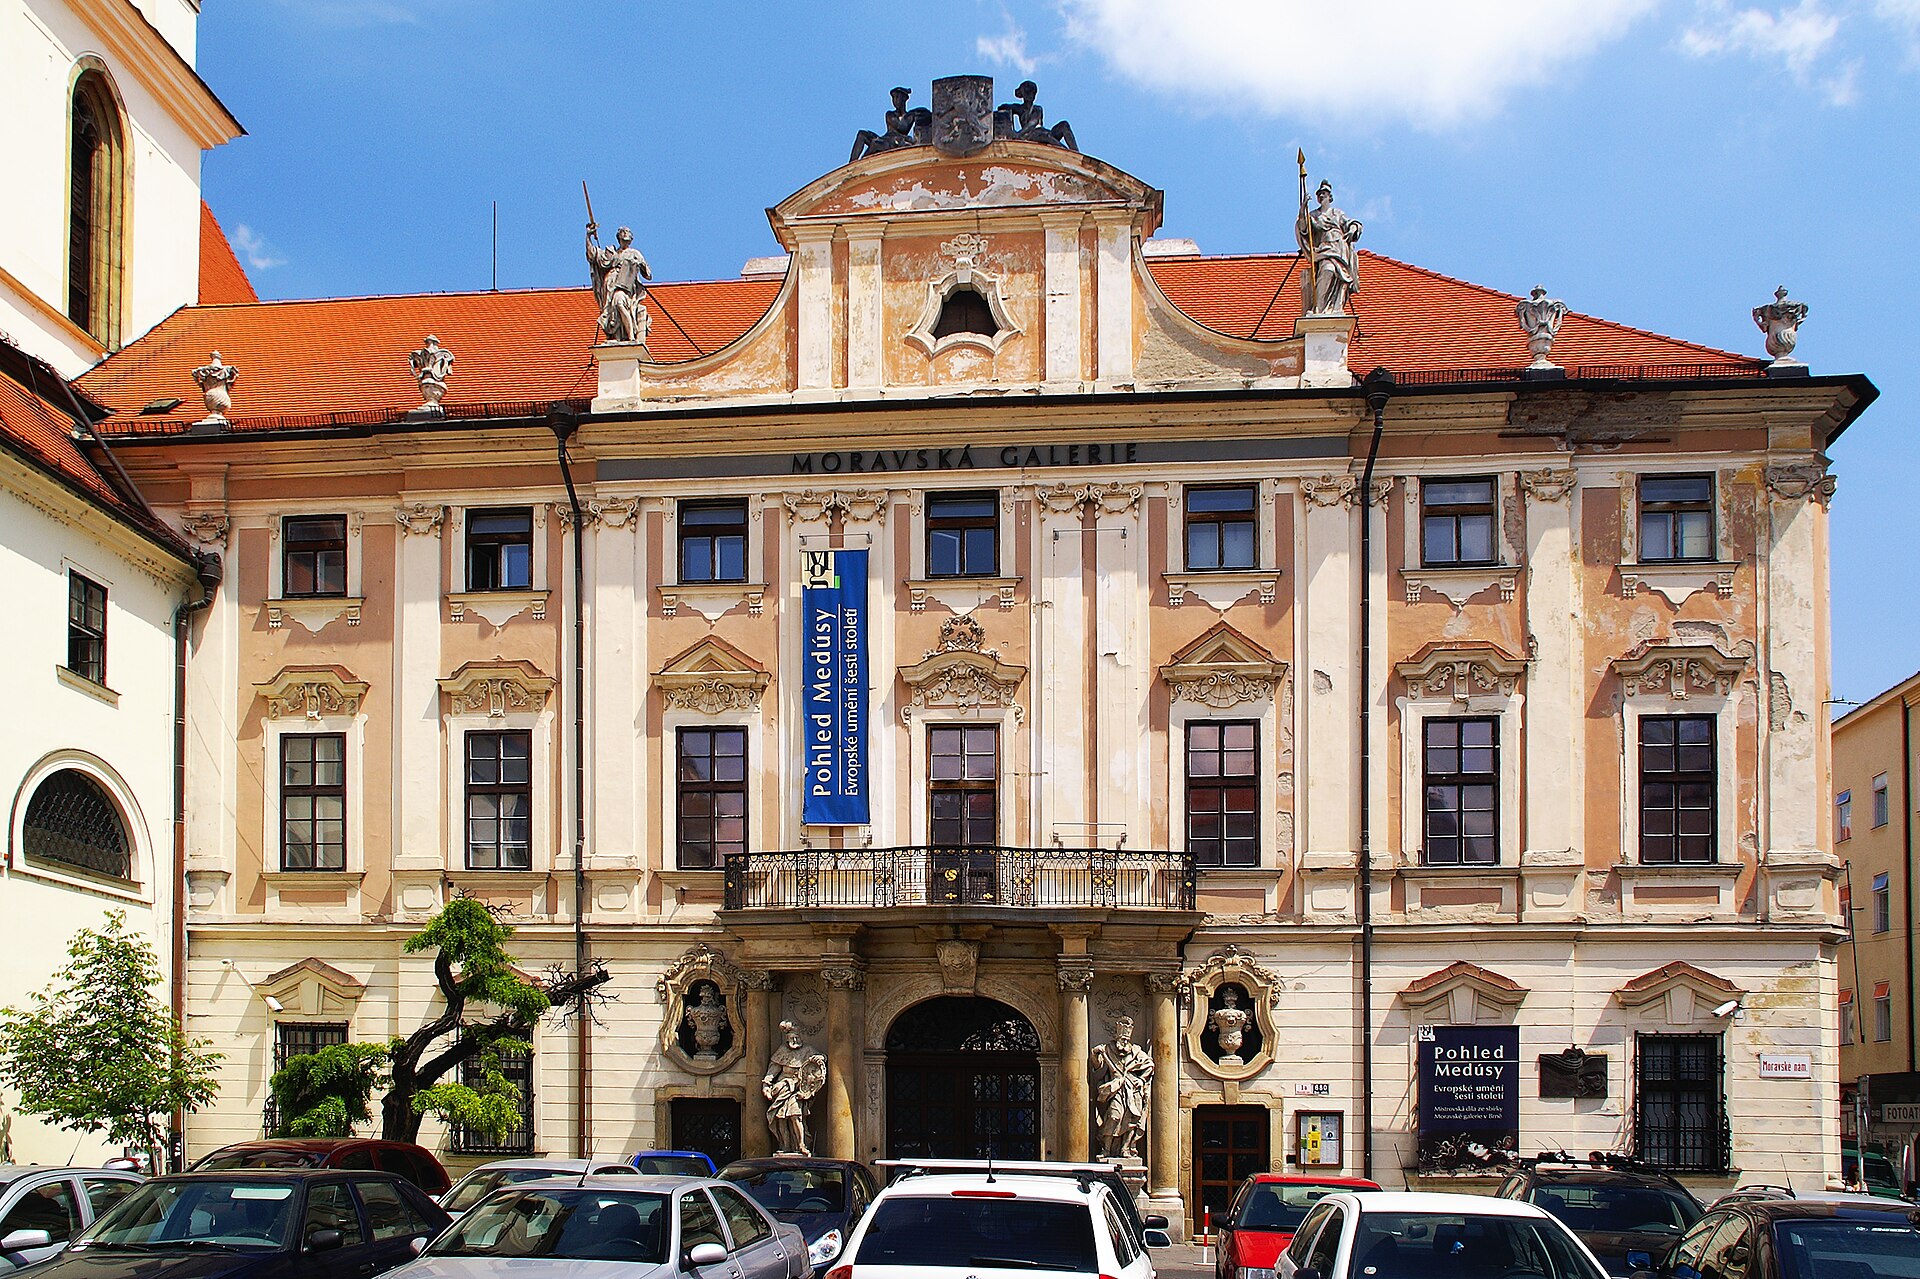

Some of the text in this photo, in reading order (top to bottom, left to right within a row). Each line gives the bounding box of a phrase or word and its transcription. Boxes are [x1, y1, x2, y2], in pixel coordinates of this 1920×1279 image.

[791, 443, 1137, 473] MORAVSKÁ GALERIE
[810, 608, 837, 796] Pohled Medúsy
[843, 607, 862, 796] Evropské umění šesti století
[1434, 1045, 1504, 1060] Pohled
[1434, 1062, 1504, 1080] Medúsy
[1433, 1084, 1504, 1094] Evropské umění
[1454, 1092, 1504, 1100] šesti století
[1887, 1106, 1920, 1120] FOTOAT
